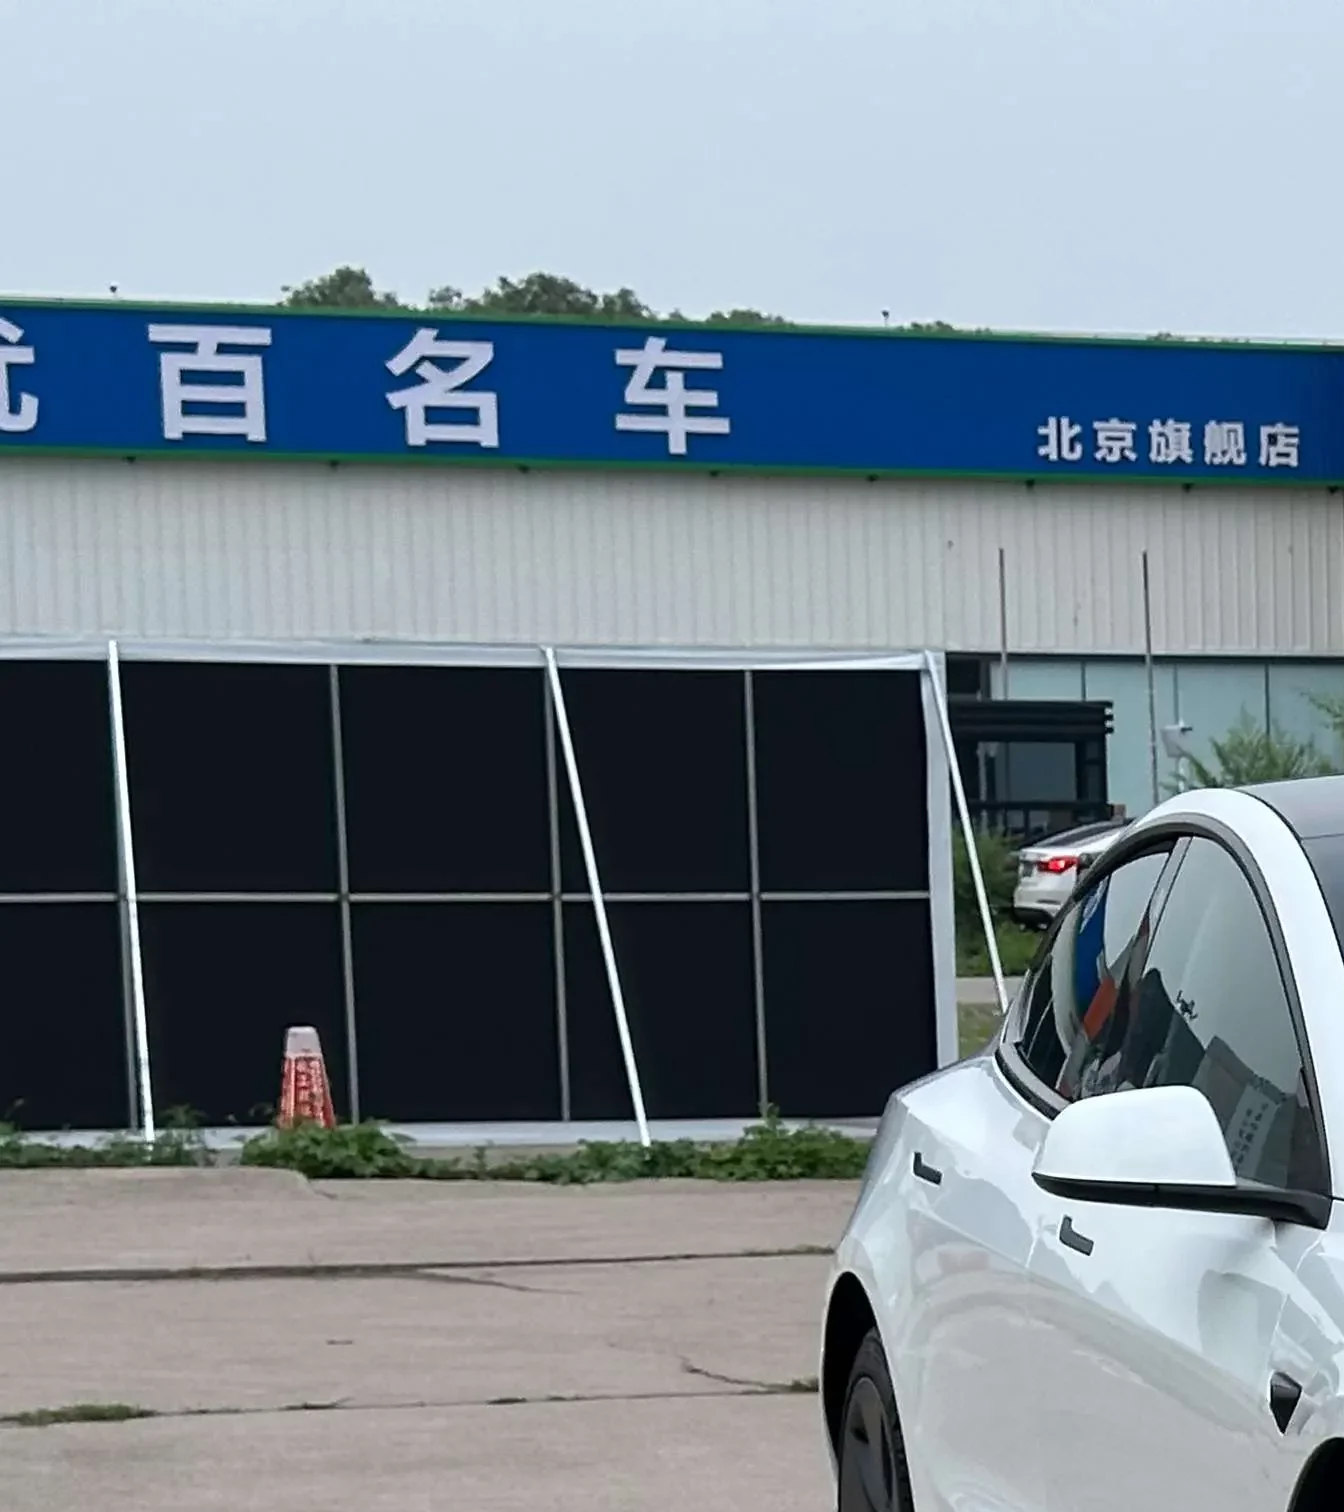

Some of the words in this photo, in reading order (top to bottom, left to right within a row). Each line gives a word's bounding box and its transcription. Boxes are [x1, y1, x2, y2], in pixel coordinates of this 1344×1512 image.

[1037, 416, 1300, 468] 北京旗舰店
